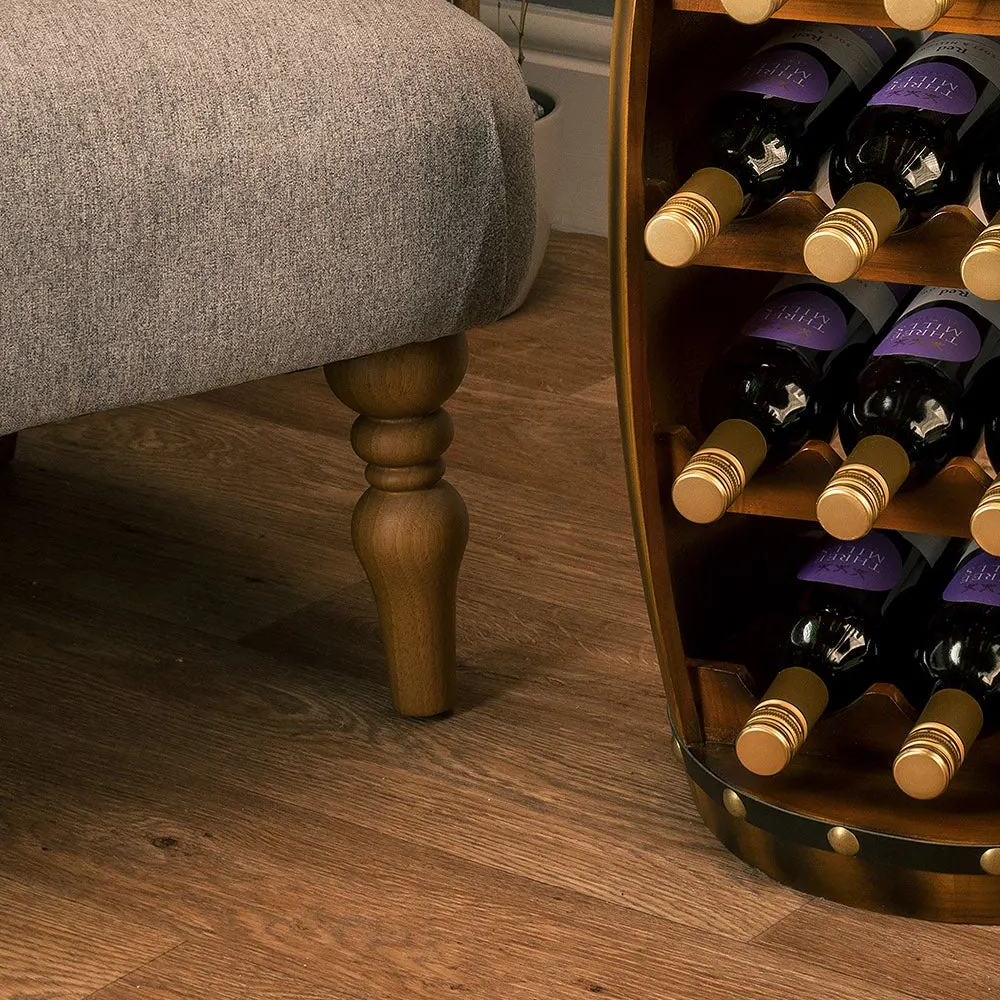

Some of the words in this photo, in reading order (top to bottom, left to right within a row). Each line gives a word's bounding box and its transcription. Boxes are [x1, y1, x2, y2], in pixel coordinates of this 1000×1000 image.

[936, 46, 968, 54] Red
[938, 289, 970, 298] Red
[893, 329, 958, 346] THREE
